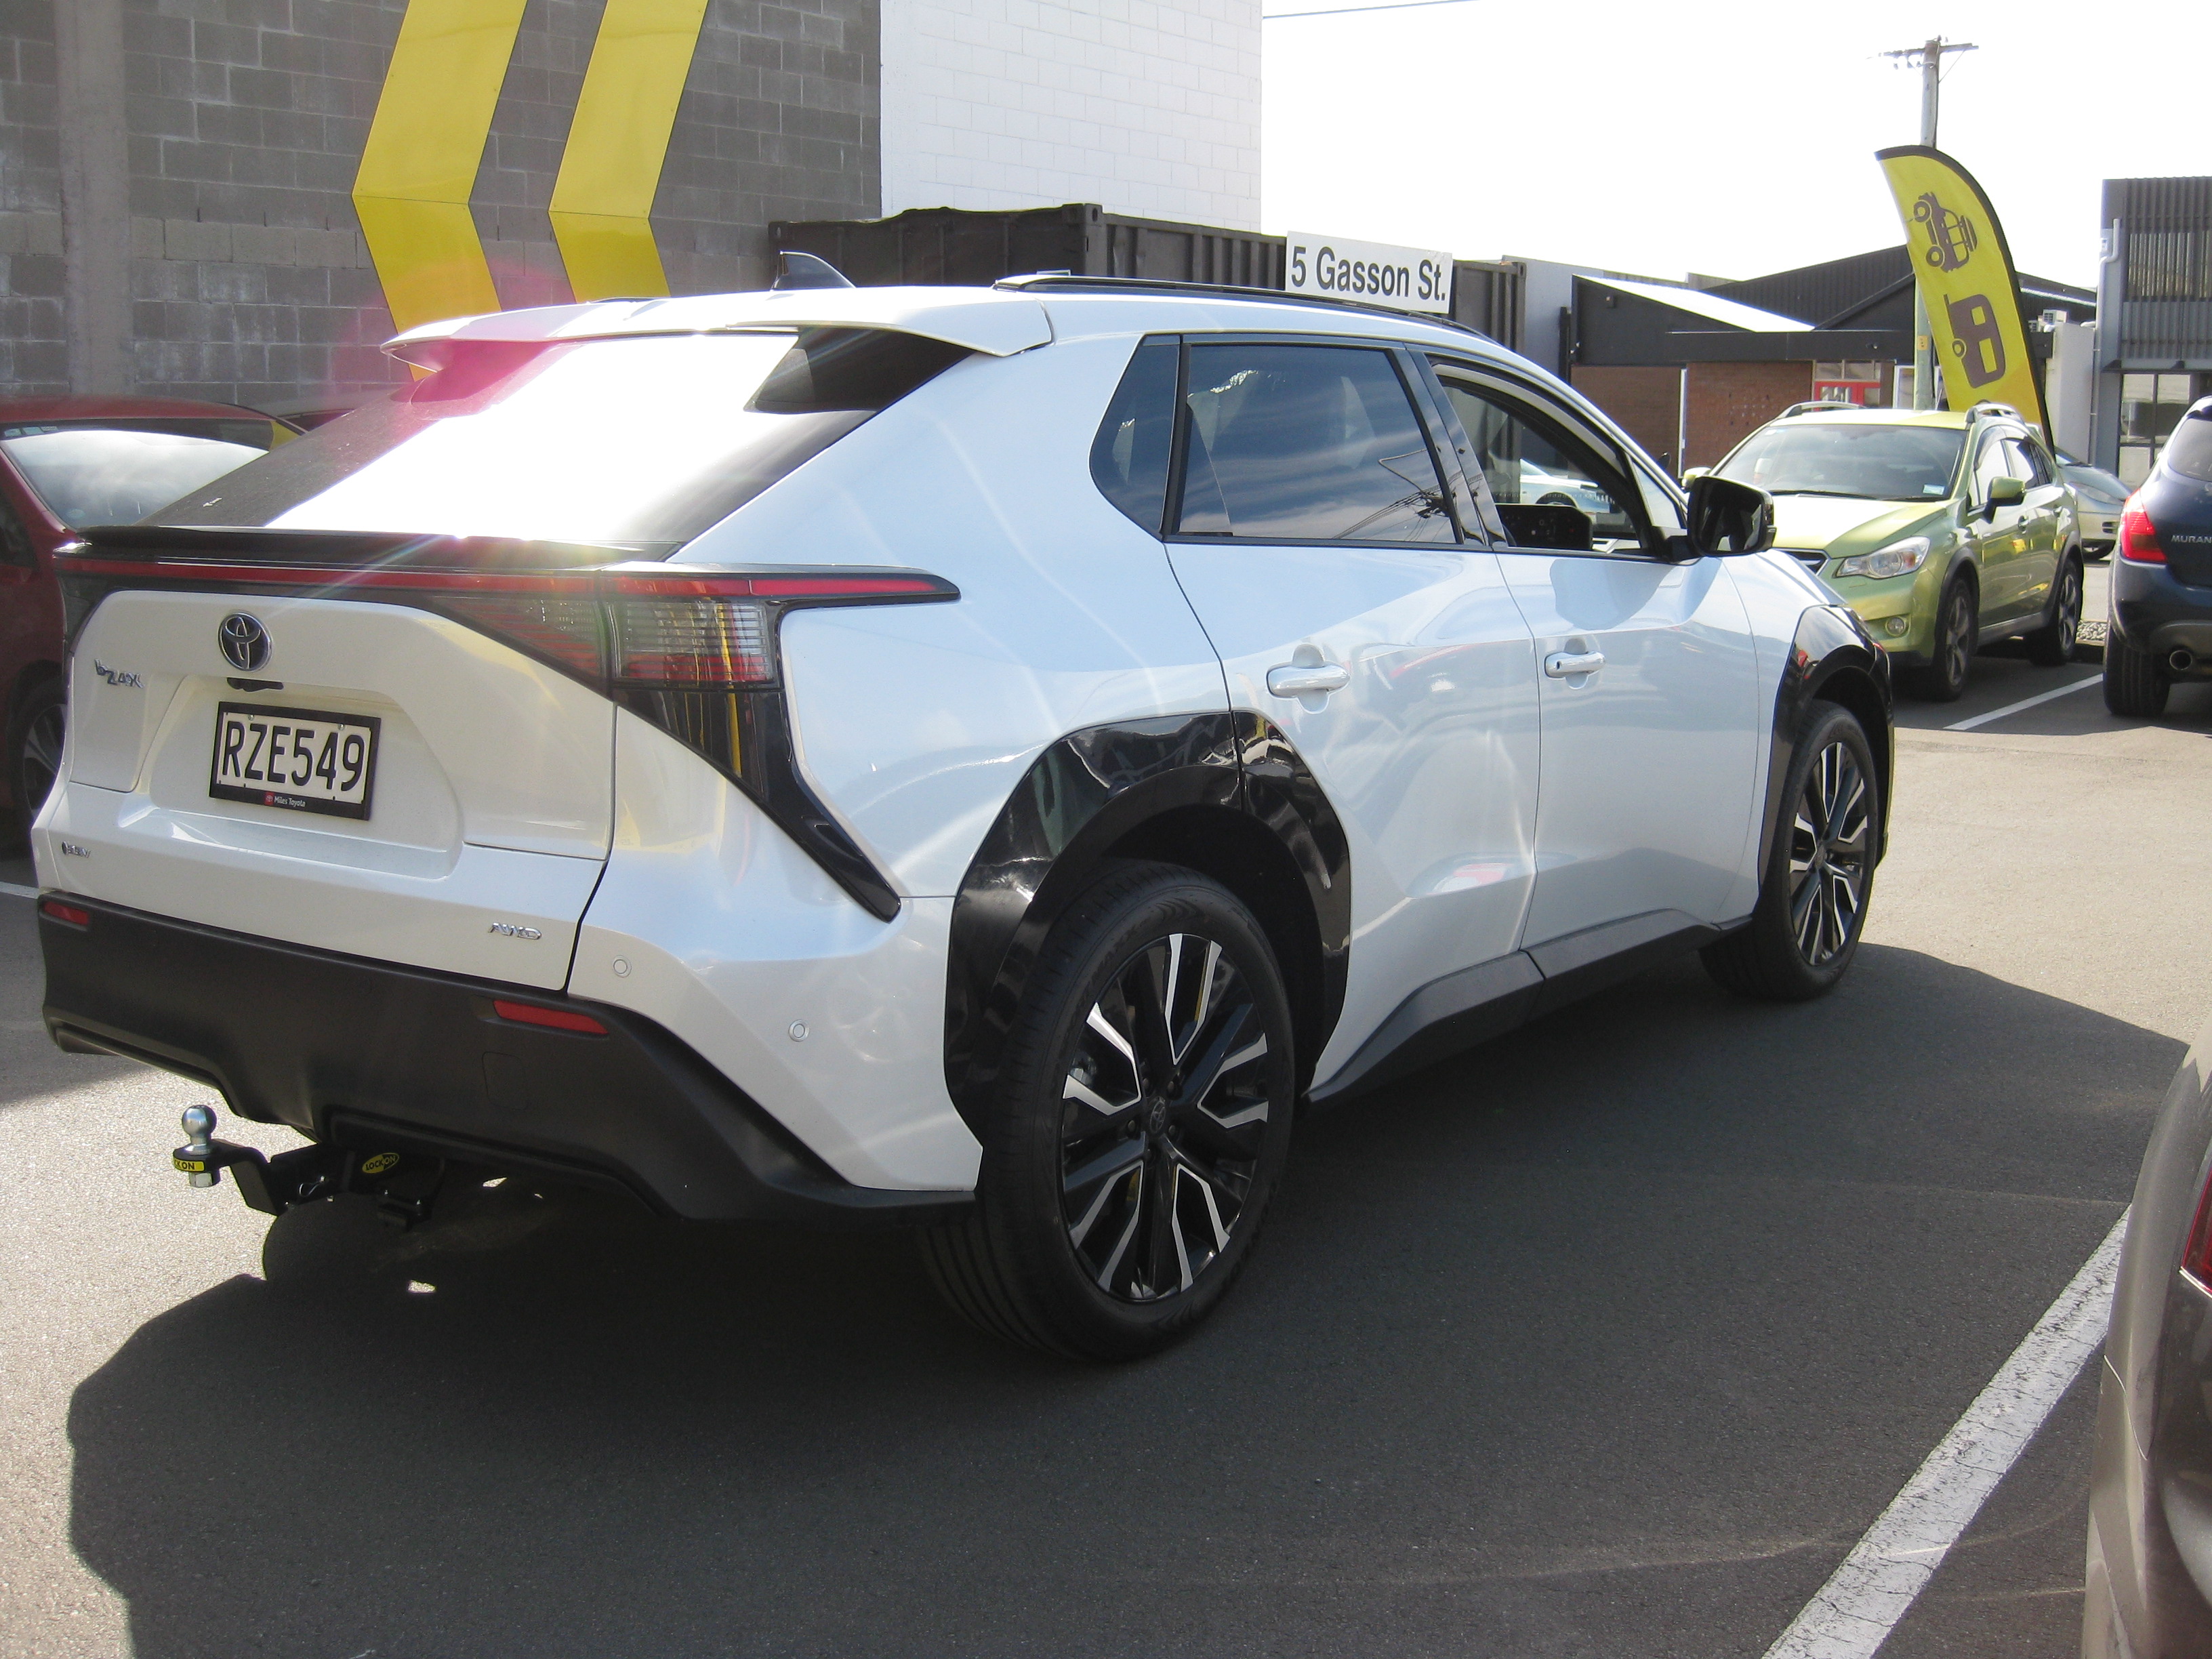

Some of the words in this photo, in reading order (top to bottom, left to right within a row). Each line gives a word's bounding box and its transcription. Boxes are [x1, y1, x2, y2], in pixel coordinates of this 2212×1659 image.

[1291, 246, 1307, 287] 5
[1316, 247, 1410, 297] Gasson
[1418, 259, 1446, 301] St.
[222, 720, 365, 792] RZE549
[274, 796, 288, 804] Miles
[289, 797, 306, 807] Toyota
[488, 922, 542, 940] AWD
